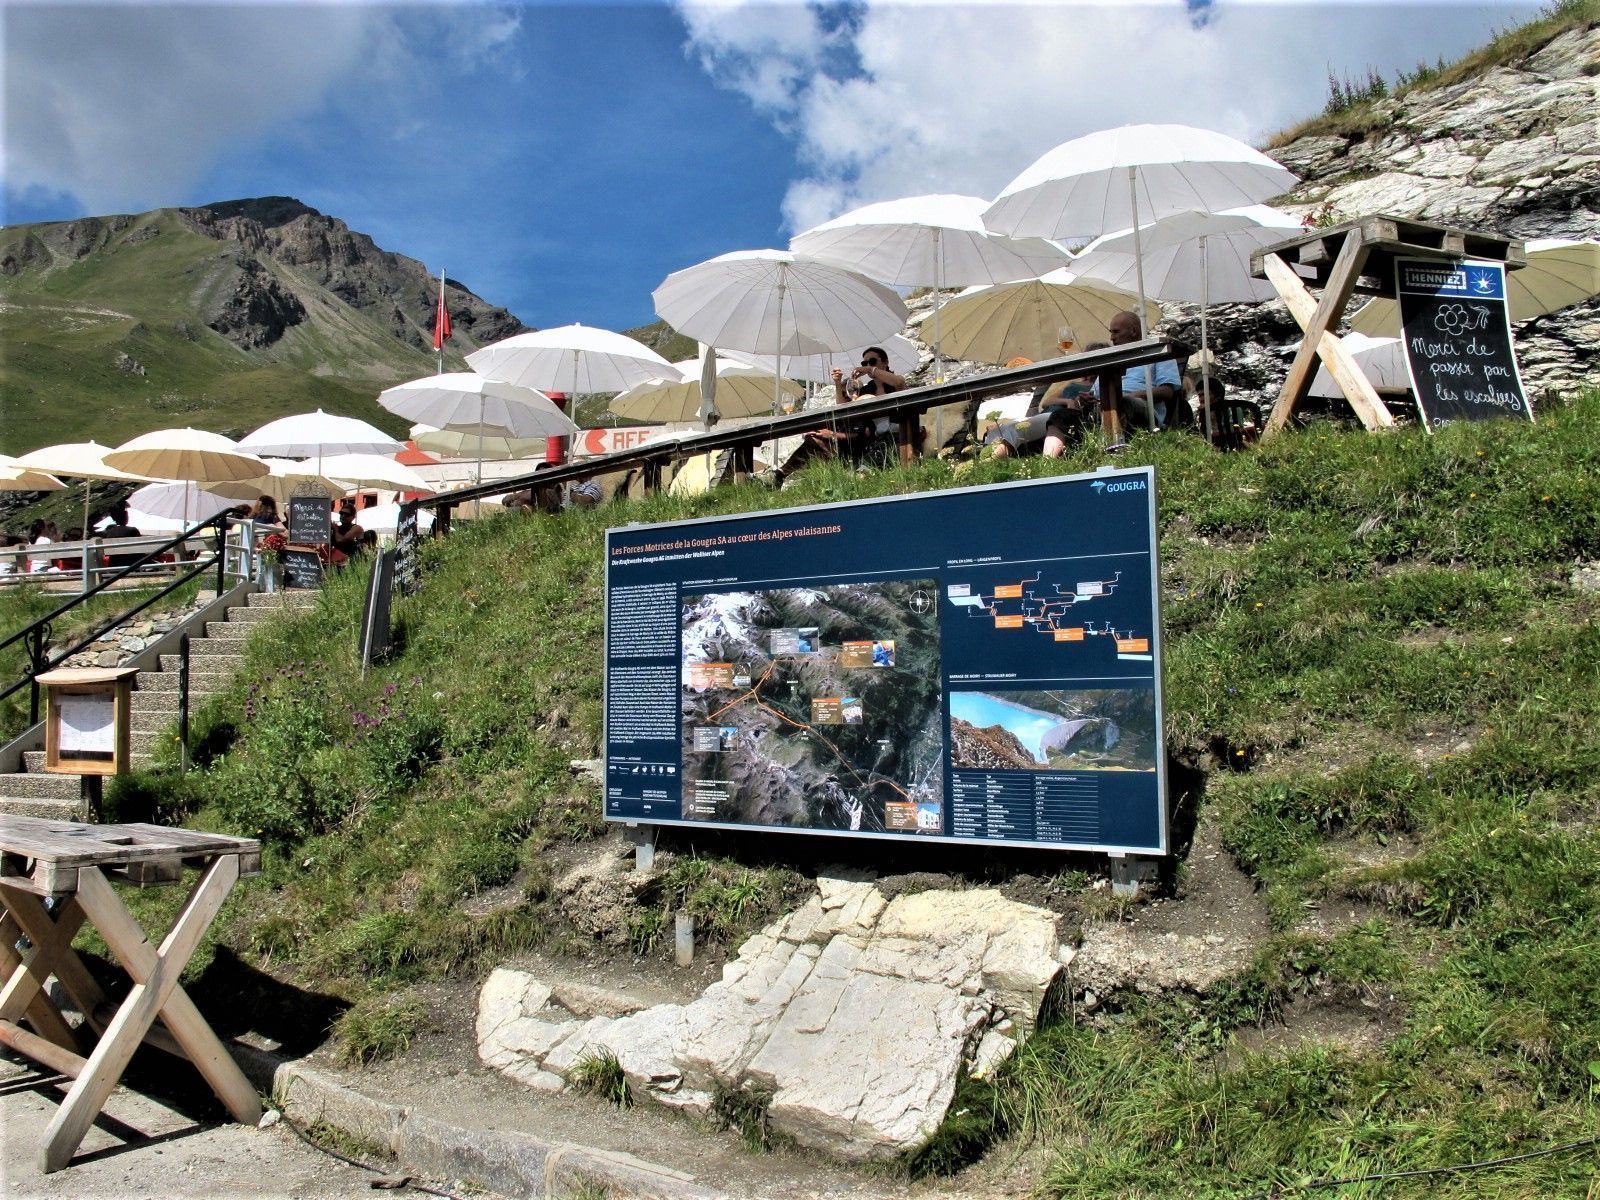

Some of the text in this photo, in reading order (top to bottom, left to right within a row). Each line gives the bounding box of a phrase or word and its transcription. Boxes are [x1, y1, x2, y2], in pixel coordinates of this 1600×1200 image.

[1411, 273, 1461, 285] HENNIEZ
[1412, 337, 1496, 358] Merci de
[1429, 361, 1511, 382] passer par
[1436, 383, 1521, 411] les escaliers
[1107, 481, 1146, 493] GOUGRA
[611, 547, 623, 556] Les
[623, 545, 644, 554] Forces
[644, 542, 674, 552] Motrices
[674, 539, 684, 548] de
[684, 539, 691, 548] la
[691, 537, 717, 549] Gougra
[717, 536, 727, 545] SA
[727, 536, 737, 544] au
[758, 531, 771, 541] des
[772, 529, 793, 540] Alpes
[794, 524, 841, 537] valaisannes
